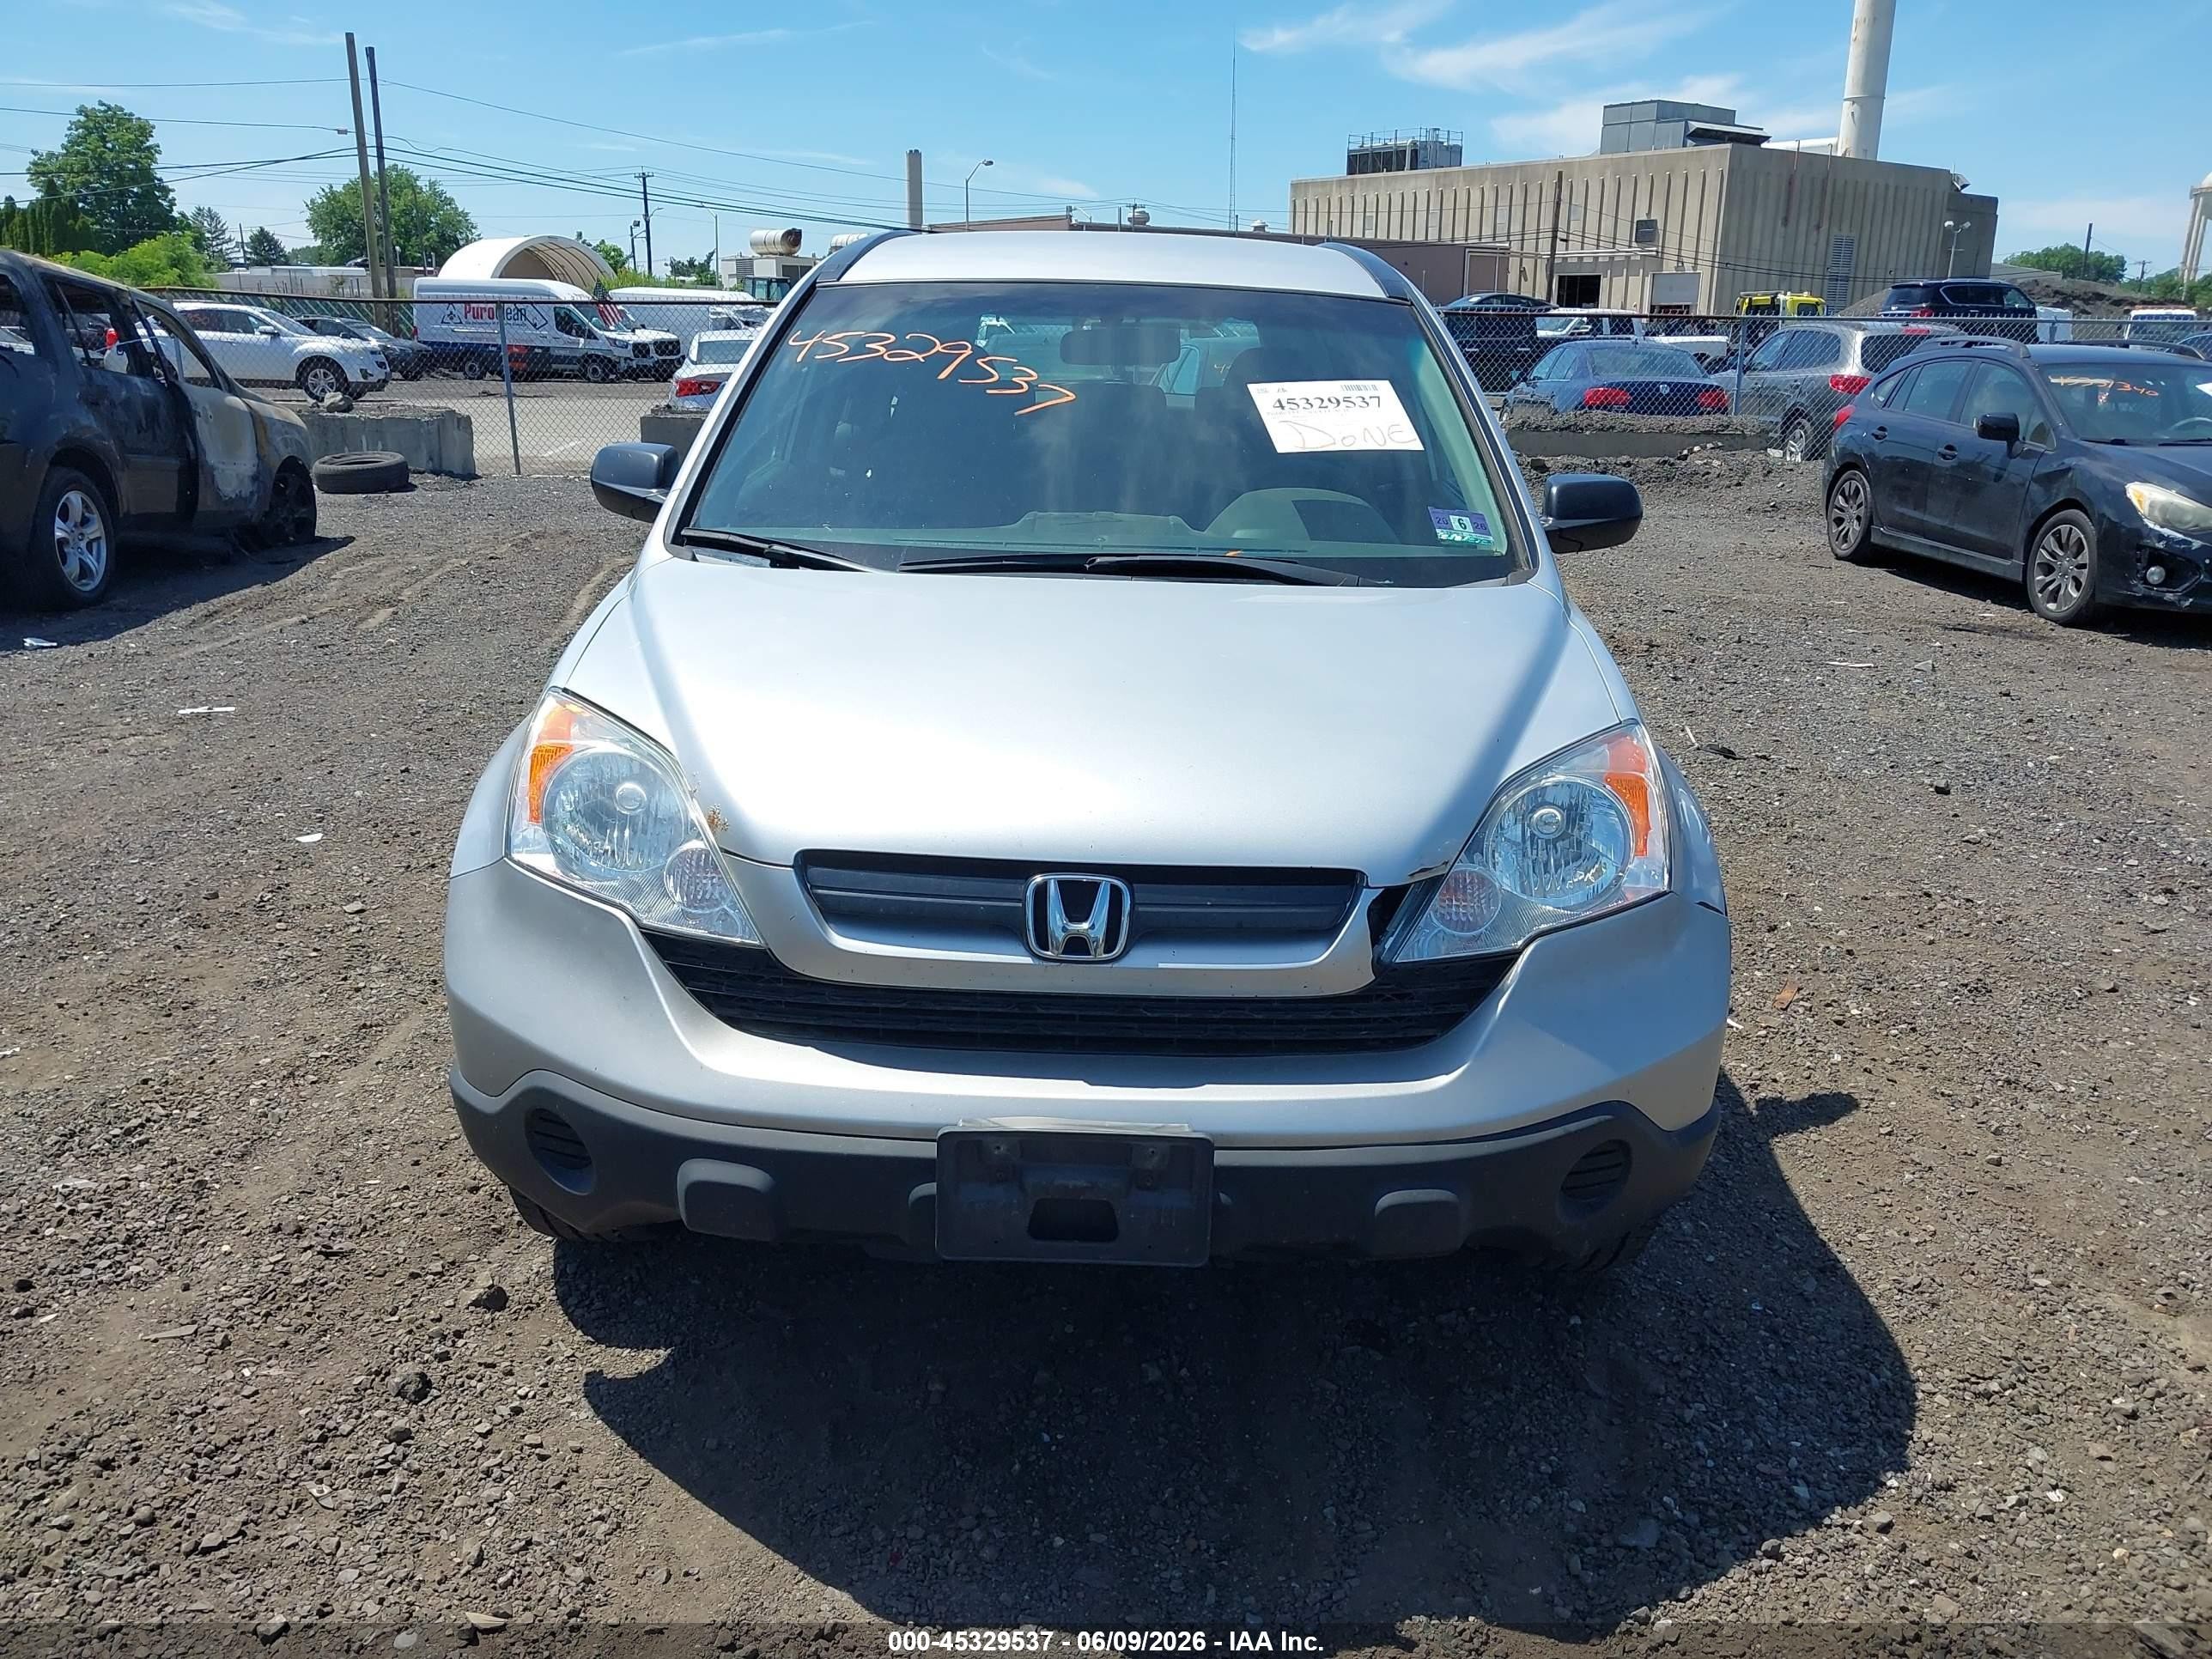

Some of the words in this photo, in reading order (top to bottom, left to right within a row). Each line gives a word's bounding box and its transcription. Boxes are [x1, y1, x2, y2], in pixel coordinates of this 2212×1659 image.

[788, 330, 1077, 416] 45329537
[1273, 395, 1381, 410] 45329537
[1457, 518, 1468, 530] 6
[1473, 521, 1487, 531] 26
